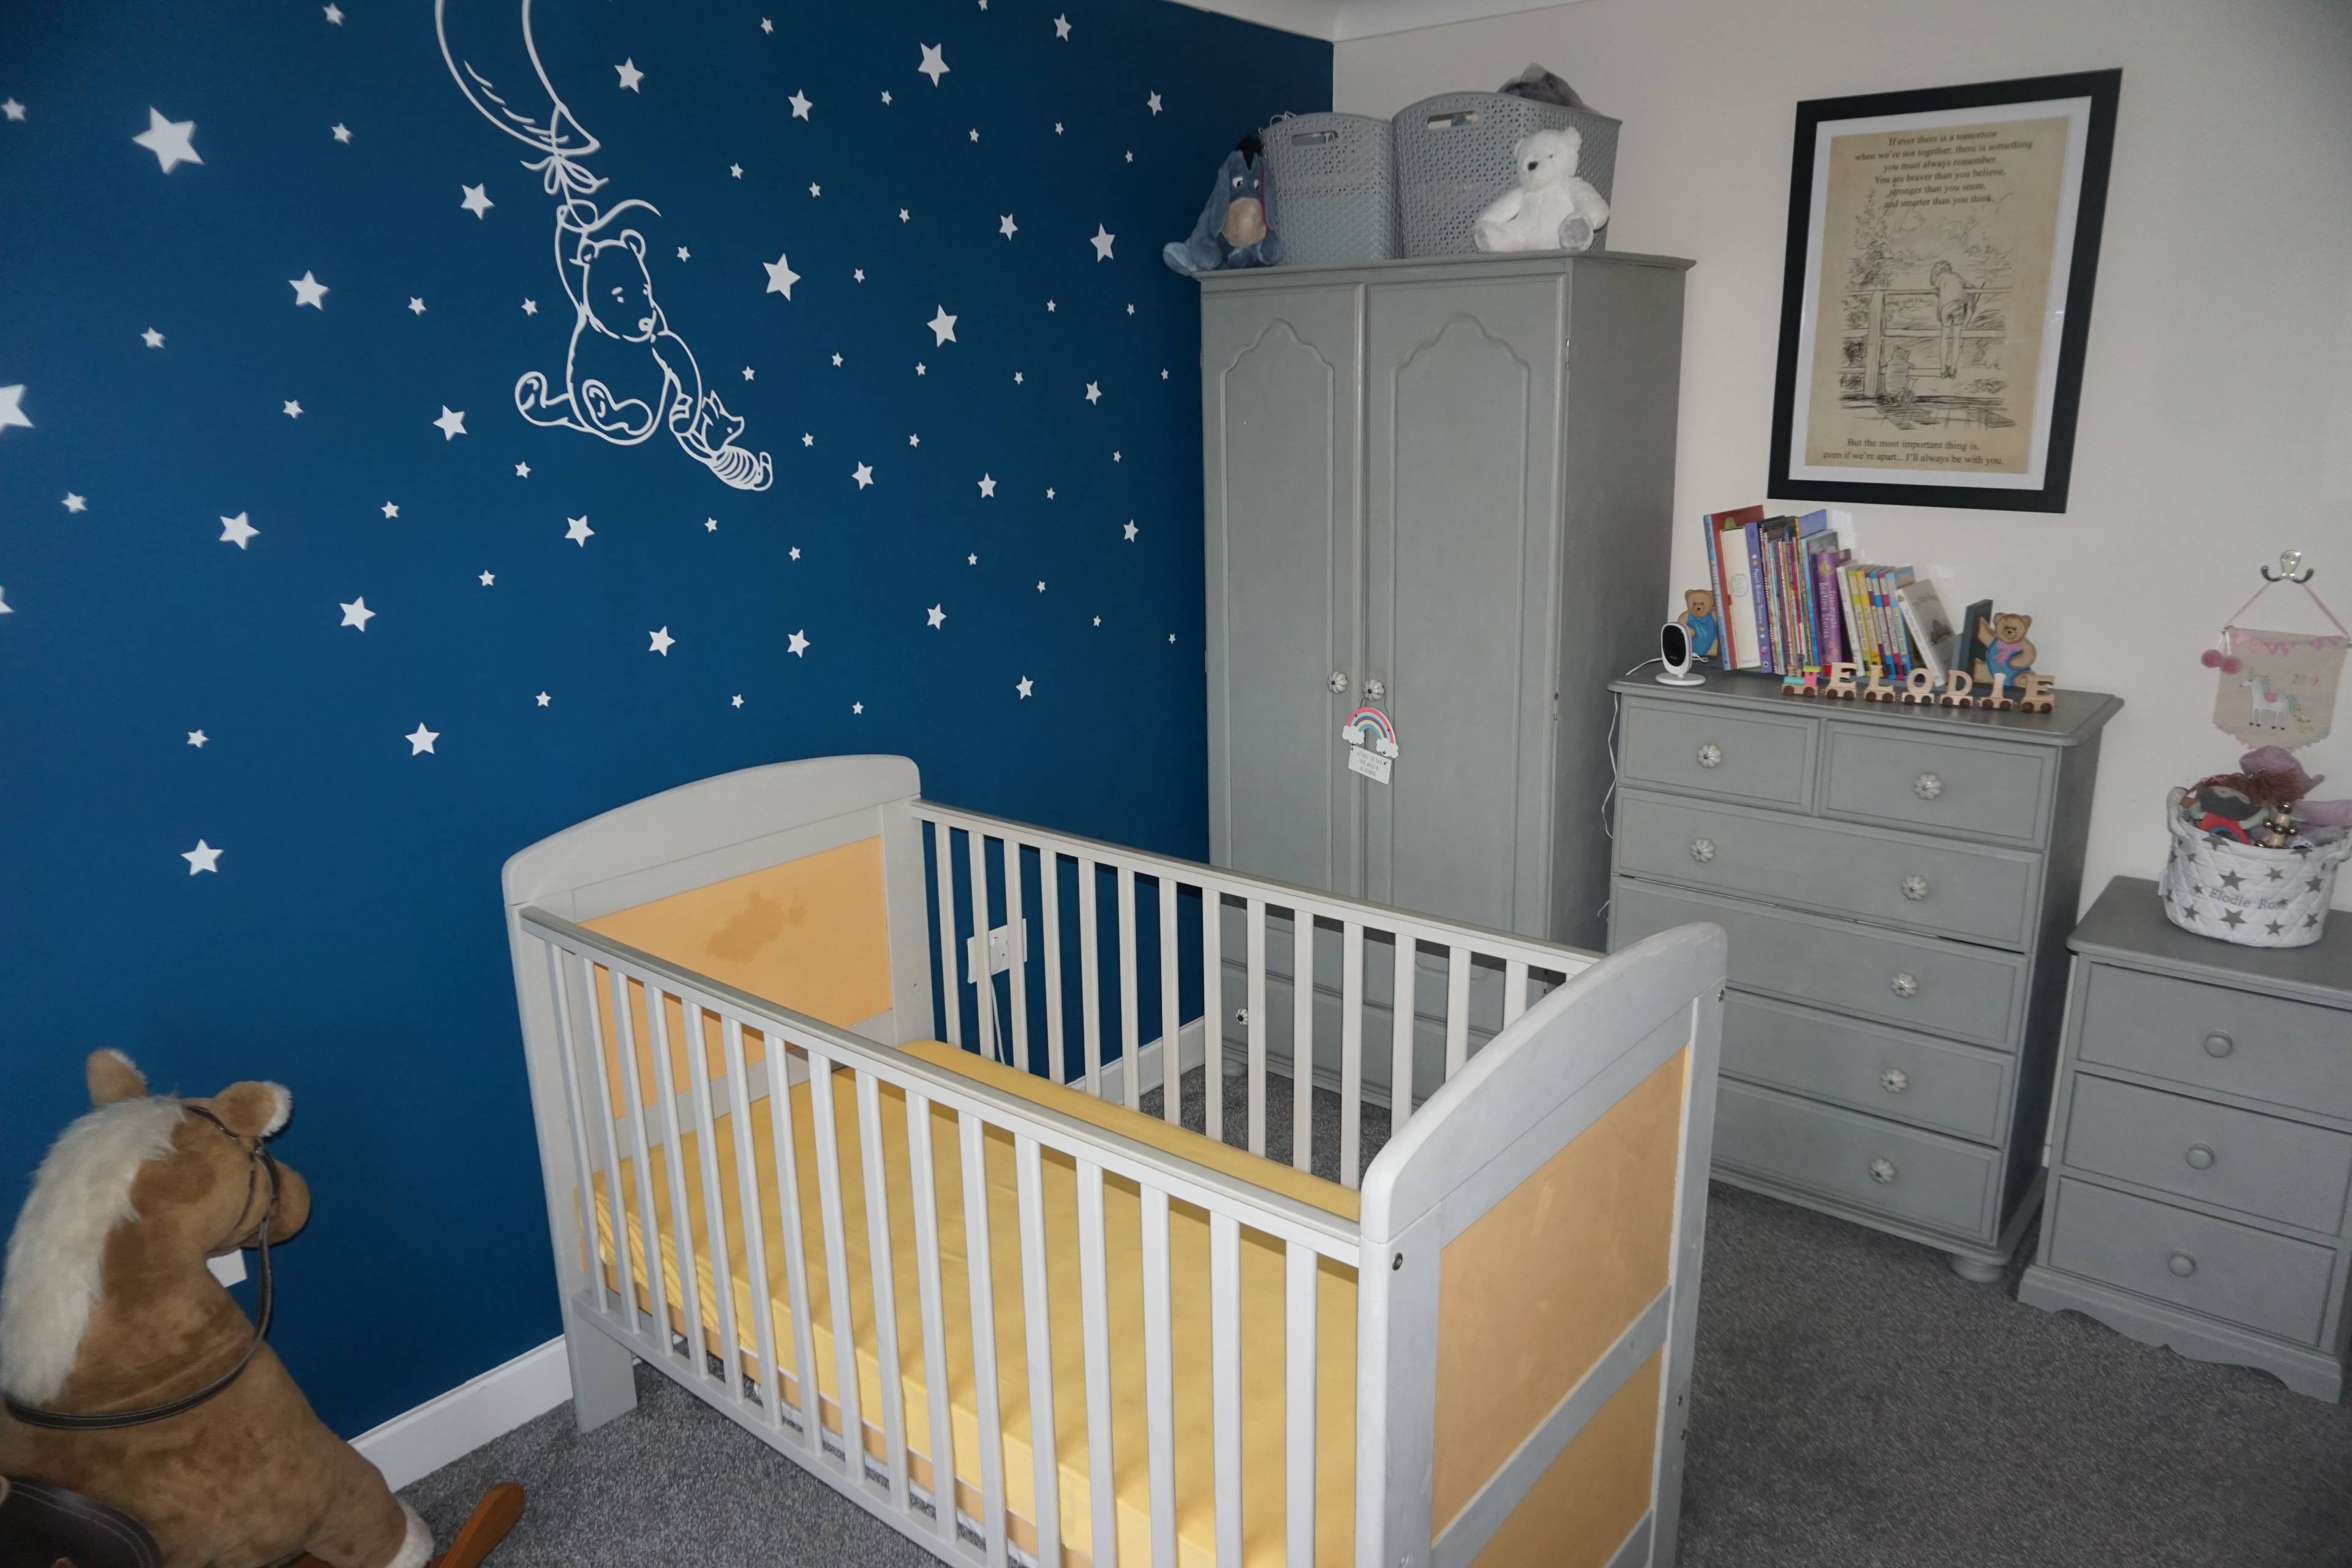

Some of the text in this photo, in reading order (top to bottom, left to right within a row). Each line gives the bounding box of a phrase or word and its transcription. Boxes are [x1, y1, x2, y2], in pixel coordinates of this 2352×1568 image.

[1888, 137, 1896, 146] If
[1917, 135, 1937, 143] there
[1956, 131, 1998, 140] tomorrow
[1855, 152, 1875, 160] when
[1878, 150, 1901, 159] we're
[1955, 144, 1977, 153] there
[1988, 140, 2034, 151] something
[1923, 159, 1951, 168] always
[1953, 156, 1996, 166] remember
[1934, 172, 1953, 180] than
[1954, 172, 1970, 181] you
[1972, 168, 2006, 178] believe,
[1888, 186, 1923, 196] stronger
[1924, 184, 1942, 193] than
[1944, 185, 1960, 194] you
[1883, 199, 1898, 209] and
[1932, 197, 1951, 205] than
[1953, 197, 1969, 206] you
[1970, 194, 1994, 203] think,
[1847, 438, 1862, 447] But
[1864, 439, 1877, 447] the
[1902, 439, 1942, 450] important
[1945, 440, 1967, 451] thing
[1844, 451, 1851, 459] if
[1920, 454, 1950, 464] always
[1951, 454, 1962, 463] be
[1964, 455, 1983, 464] with
[1819, 582, 1830, 638] Bedtime Stories
[1830, 662, 2056, 701] ELODIE
[2209, 888, 2288, 910] Elodie Rose
